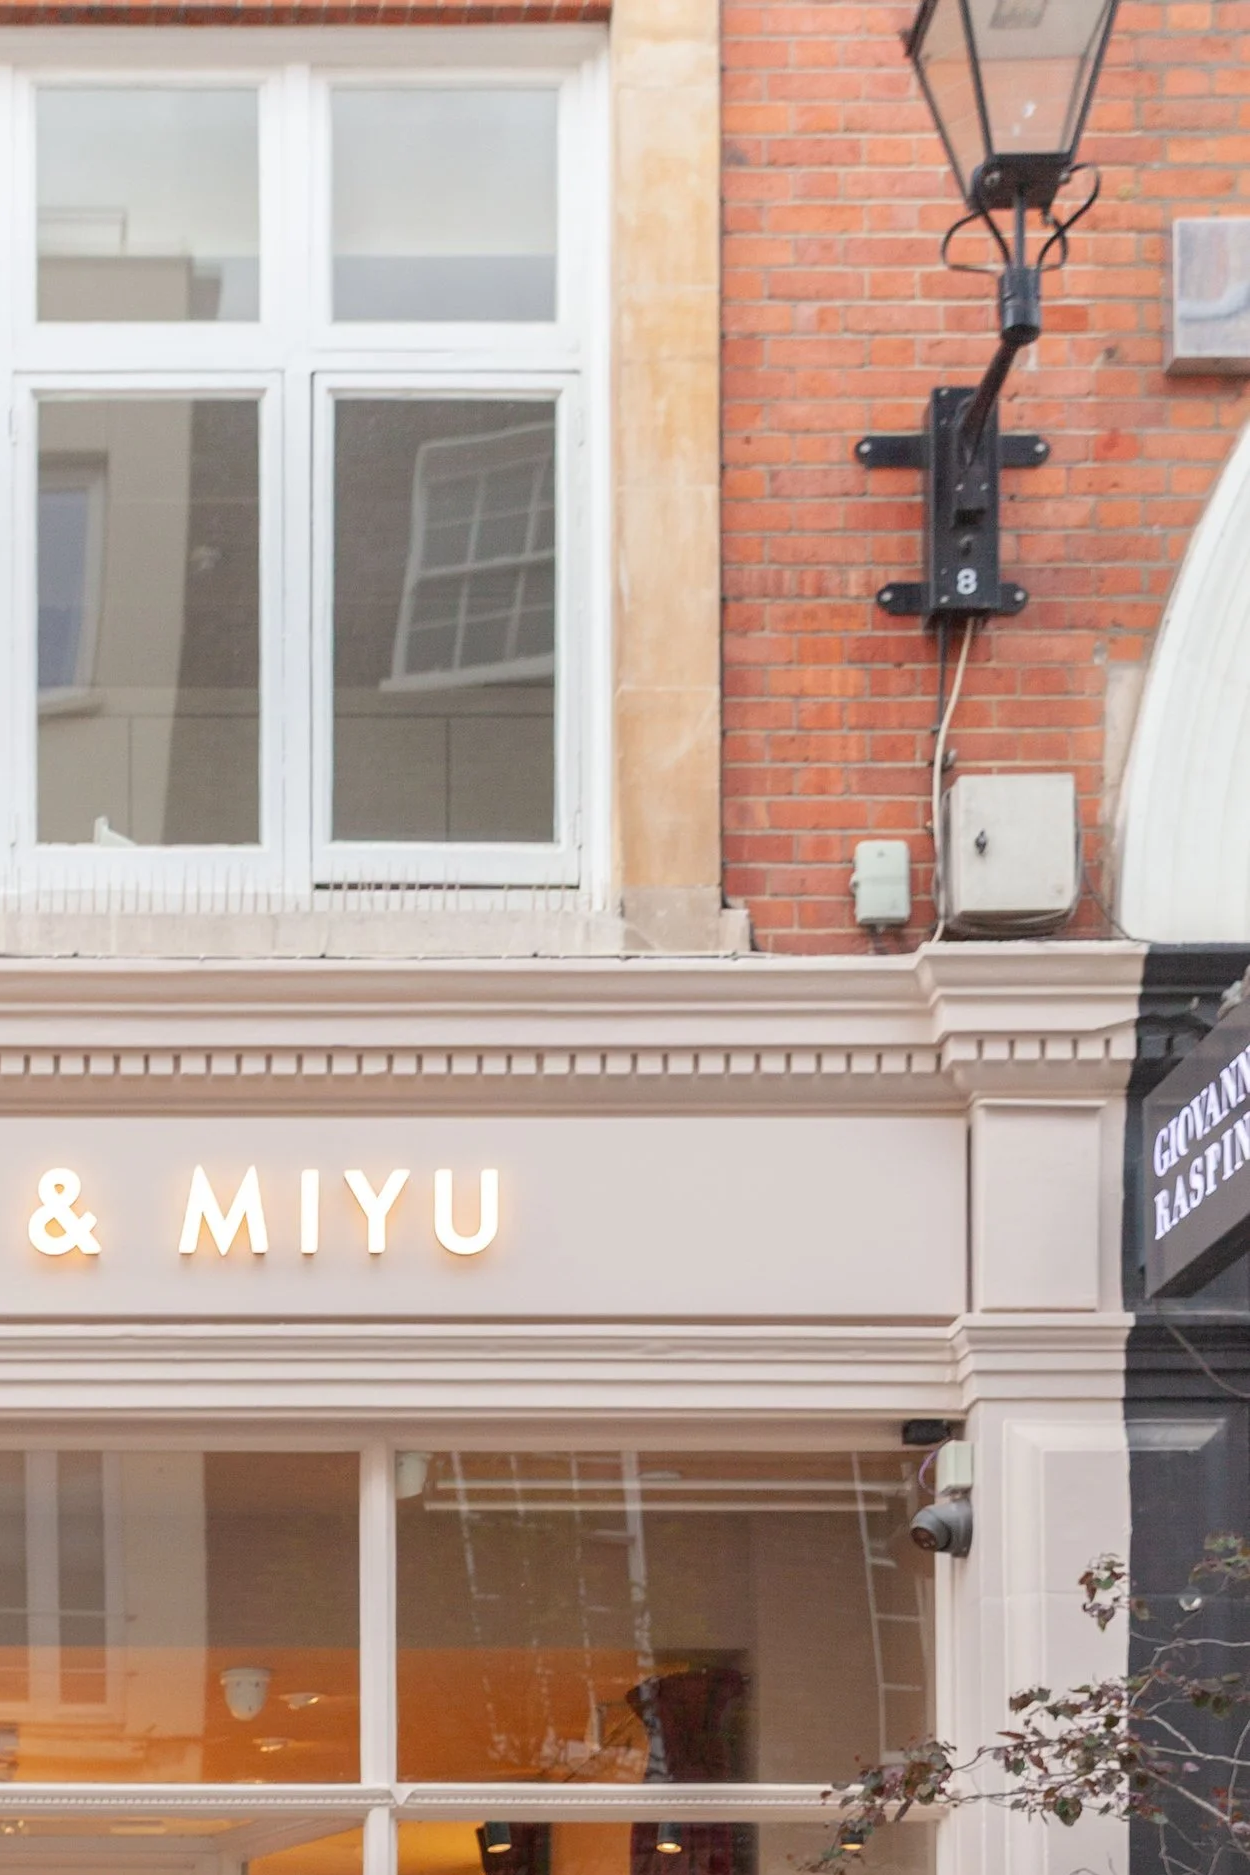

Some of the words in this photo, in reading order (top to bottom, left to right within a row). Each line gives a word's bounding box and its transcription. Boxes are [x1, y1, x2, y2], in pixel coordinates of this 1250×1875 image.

[956, 568, 978, 595] 8
[27, 1166, 102, 1256] &
[178, 1163, 500, 1256] MIYU
